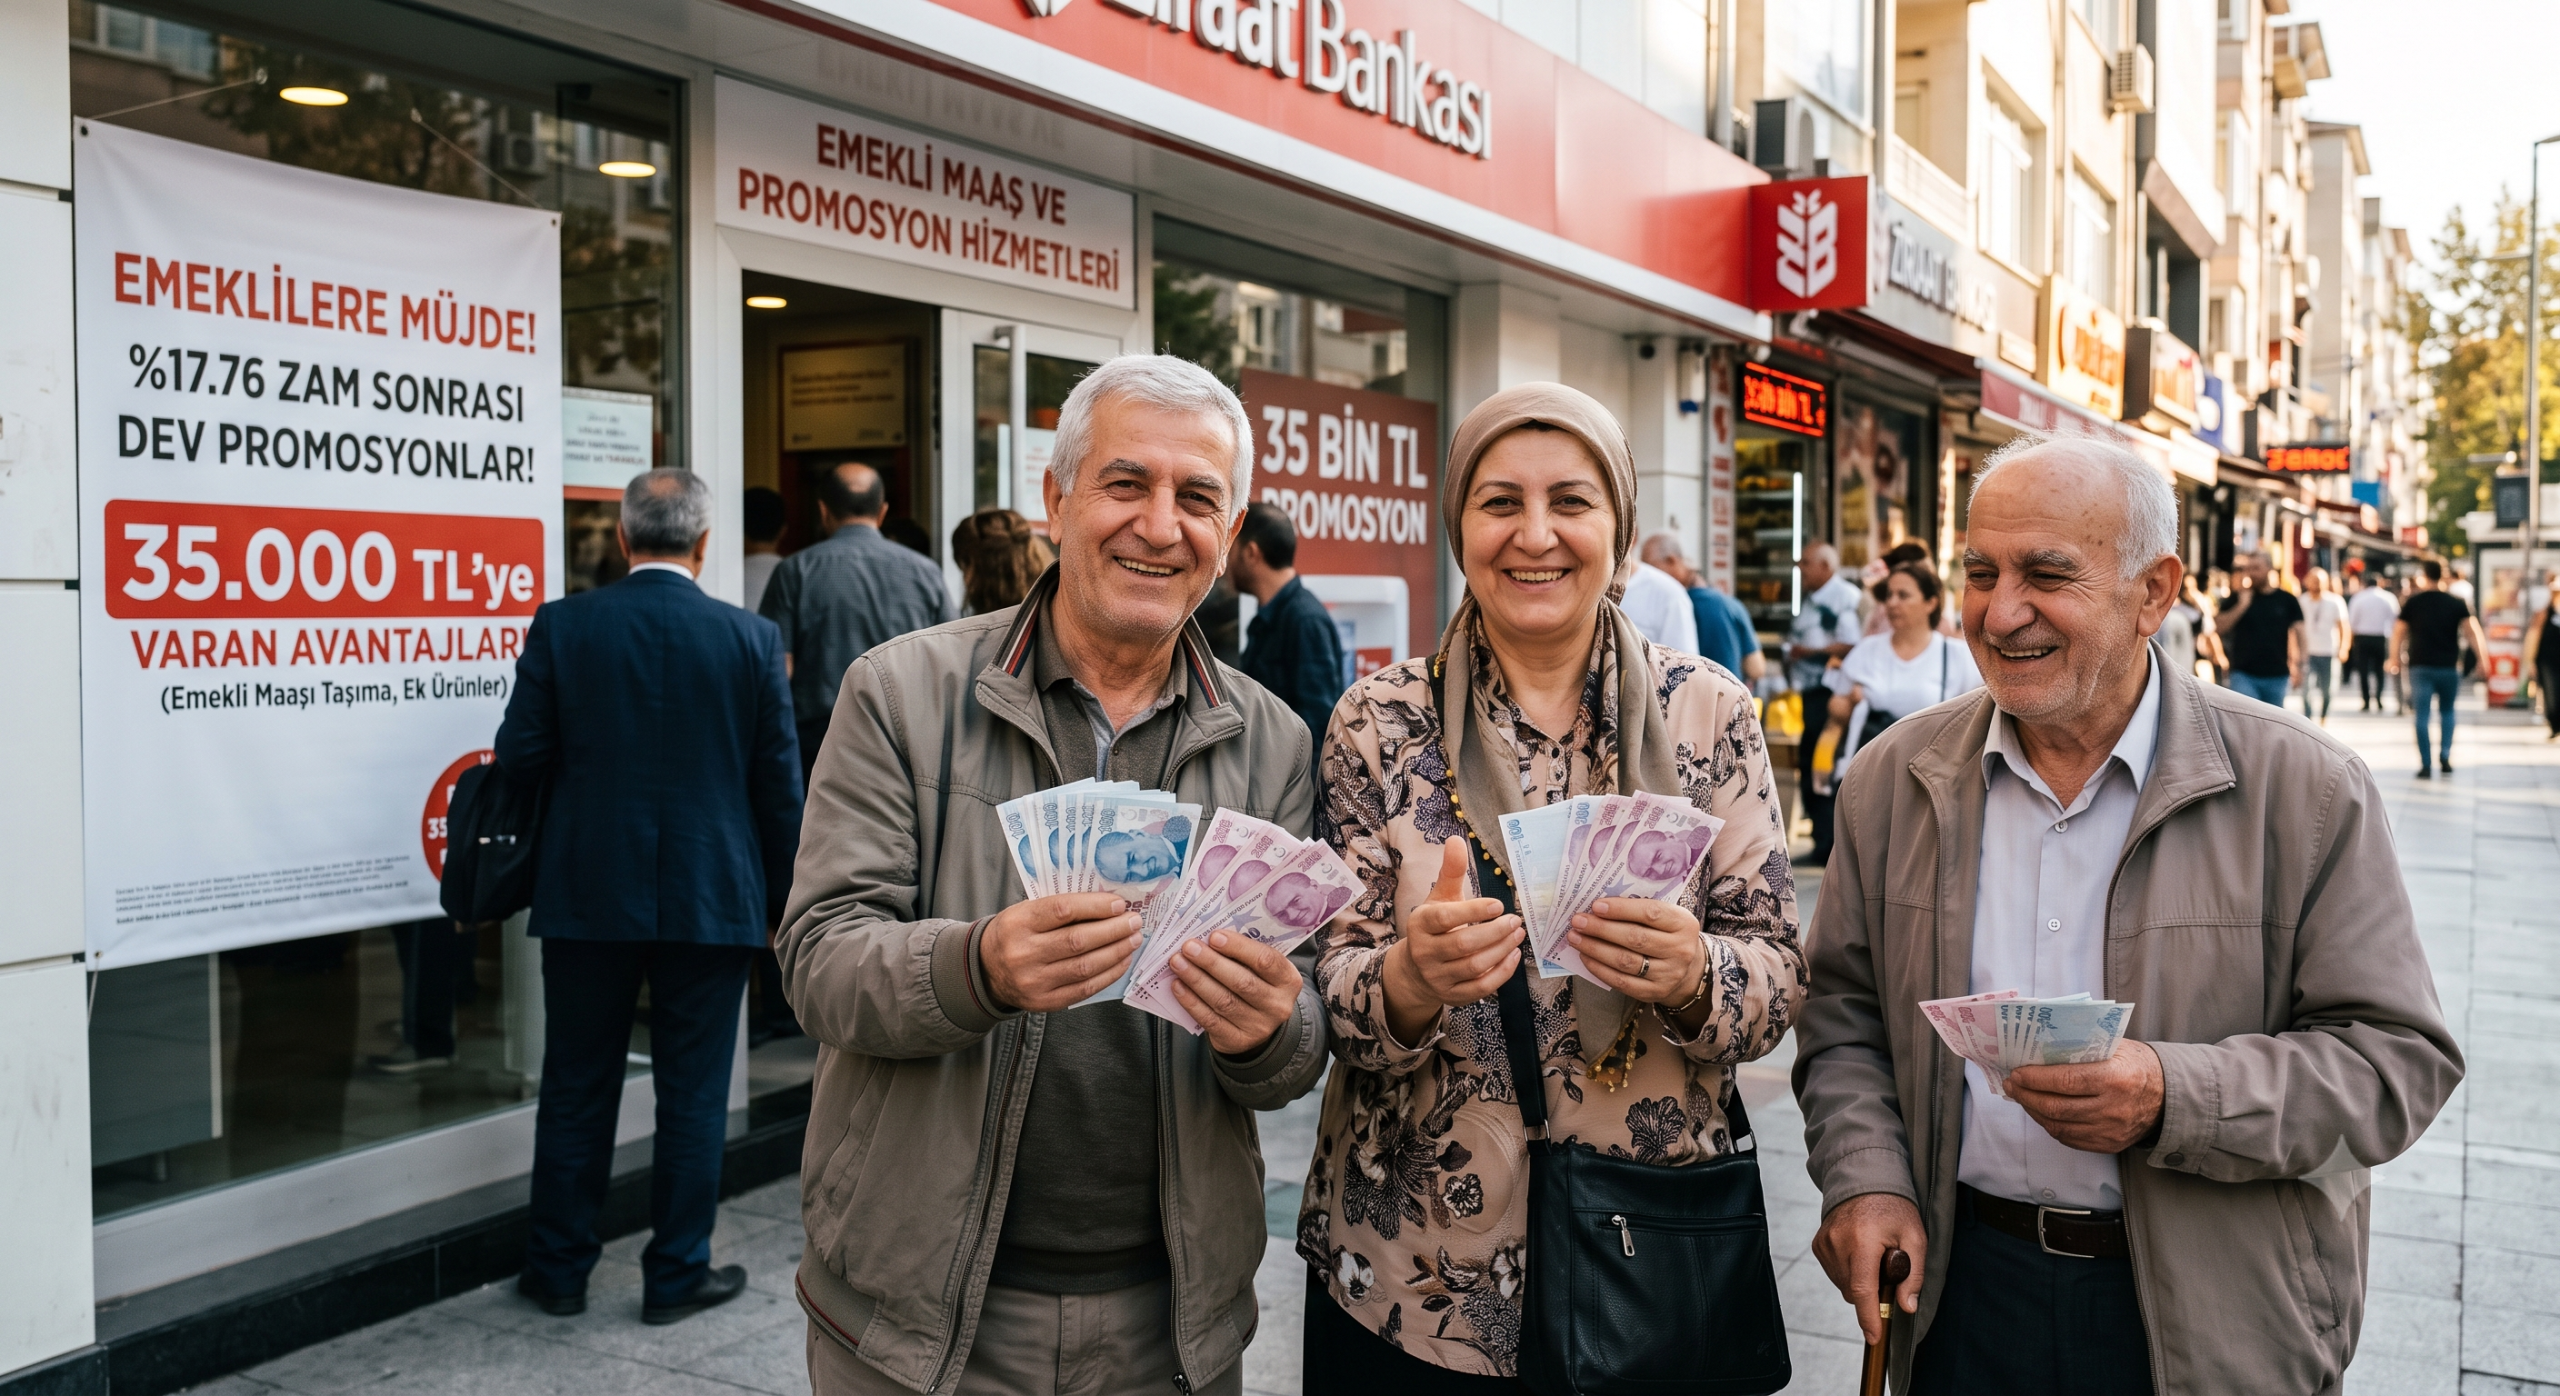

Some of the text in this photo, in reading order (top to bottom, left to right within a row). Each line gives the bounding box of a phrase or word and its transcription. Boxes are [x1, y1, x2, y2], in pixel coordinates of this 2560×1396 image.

[1305, 0, 1492, 159] Bankası
[817, 123, 1066, 226] EMEKLİ MAAŞ VE
[739, 167, 1119, 292] PROMOSYON HİZMETLERİ
[114, 251, 536, 354] EMEKLİLERE MÜJDE!
[129, 343, 523, 422] %17.76 ZAM SONRASI
[118, 415, 534, 483] DEV PROMOSYONLAR!
[1261, 403, 1428, 489] 35 BİN TL
[122, 523, 535, 610] 35.000 TL’ye
[130, 629, 277, 669] VARAN
[161, 673, 508, 714] (Emekli Maaşı Taşıma, Ek Ürünler)
